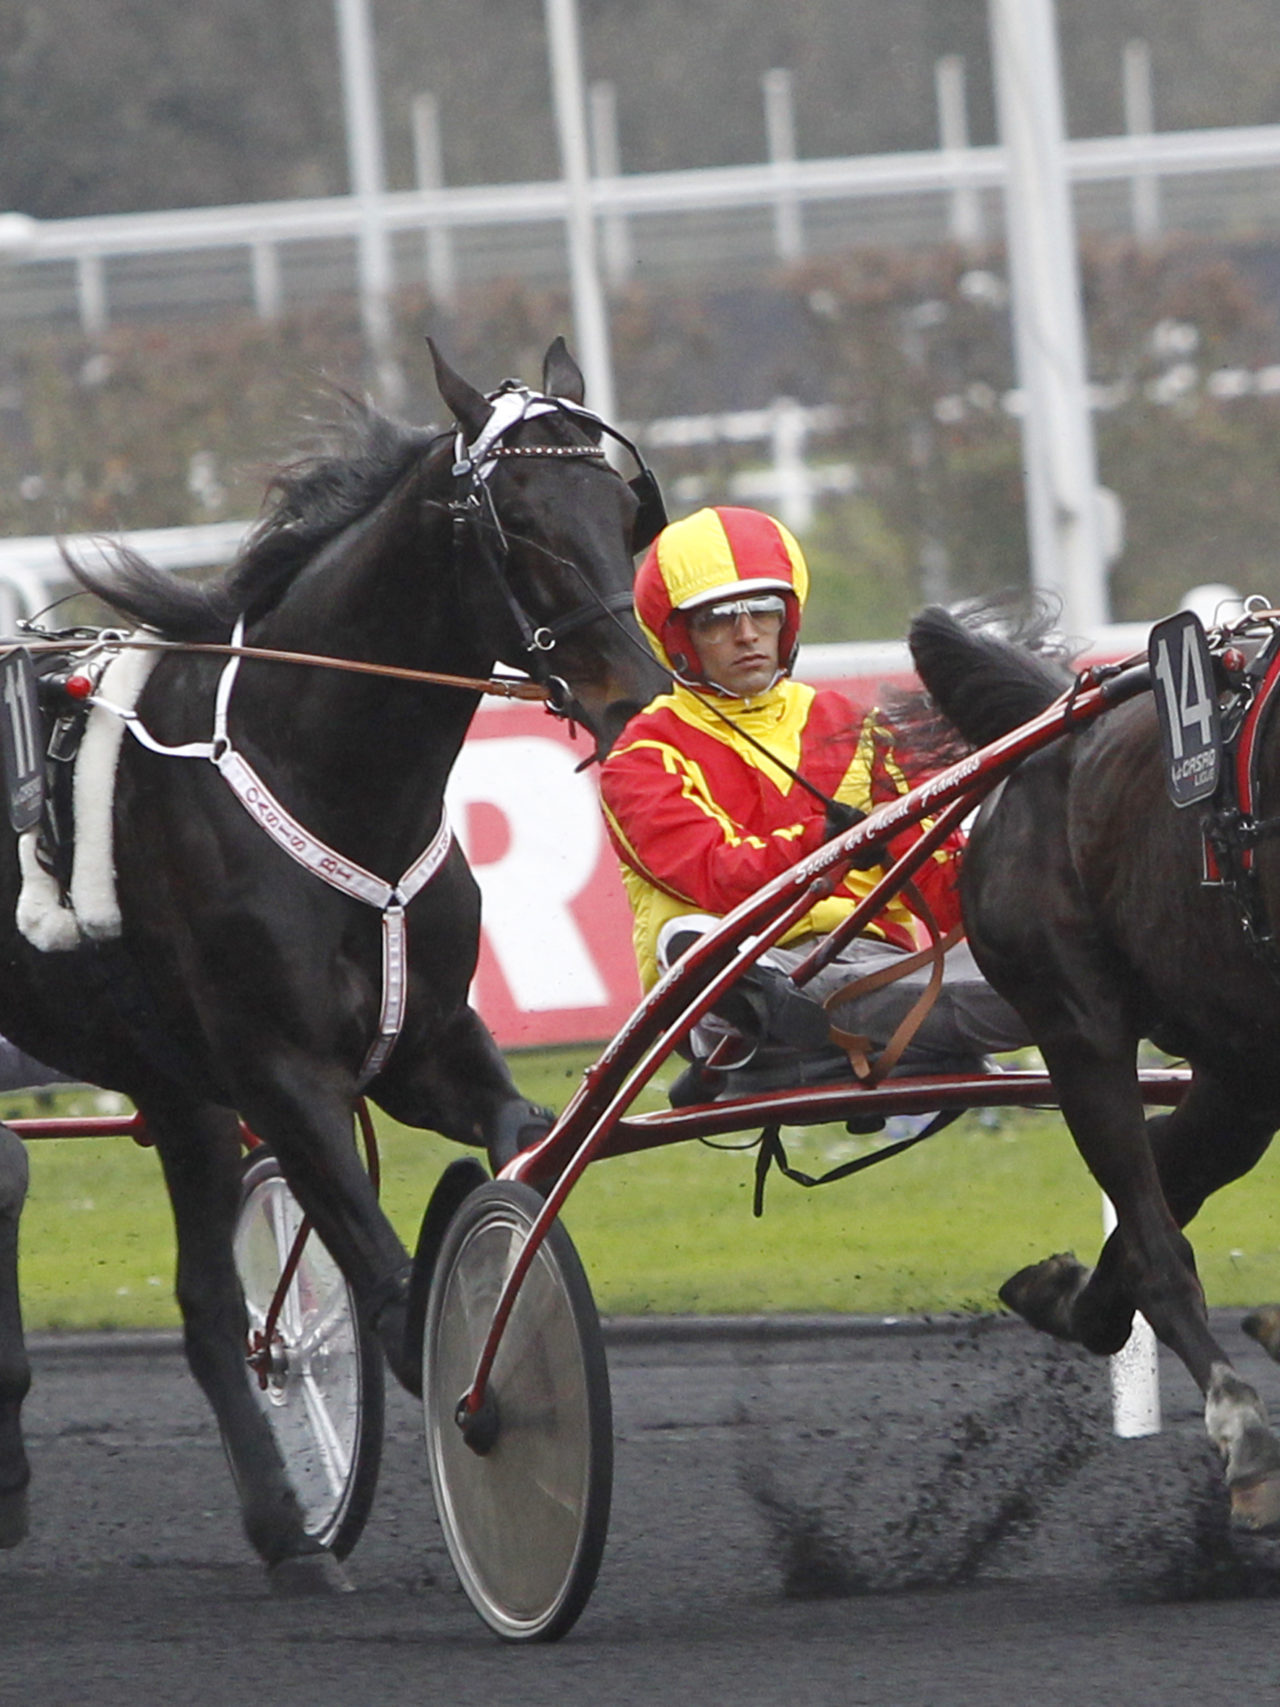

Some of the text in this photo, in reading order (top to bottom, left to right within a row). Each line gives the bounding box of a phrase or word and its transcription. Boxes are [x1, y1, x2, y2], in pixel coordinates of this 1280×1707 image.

[4, 658, 36, 779] 11
[1155, 625, 1213, 760] 14
[246, 786, 308, 853] OASIS
[866, 795, 913, 839] Cheval
[919, 756, 982, 807] Français
